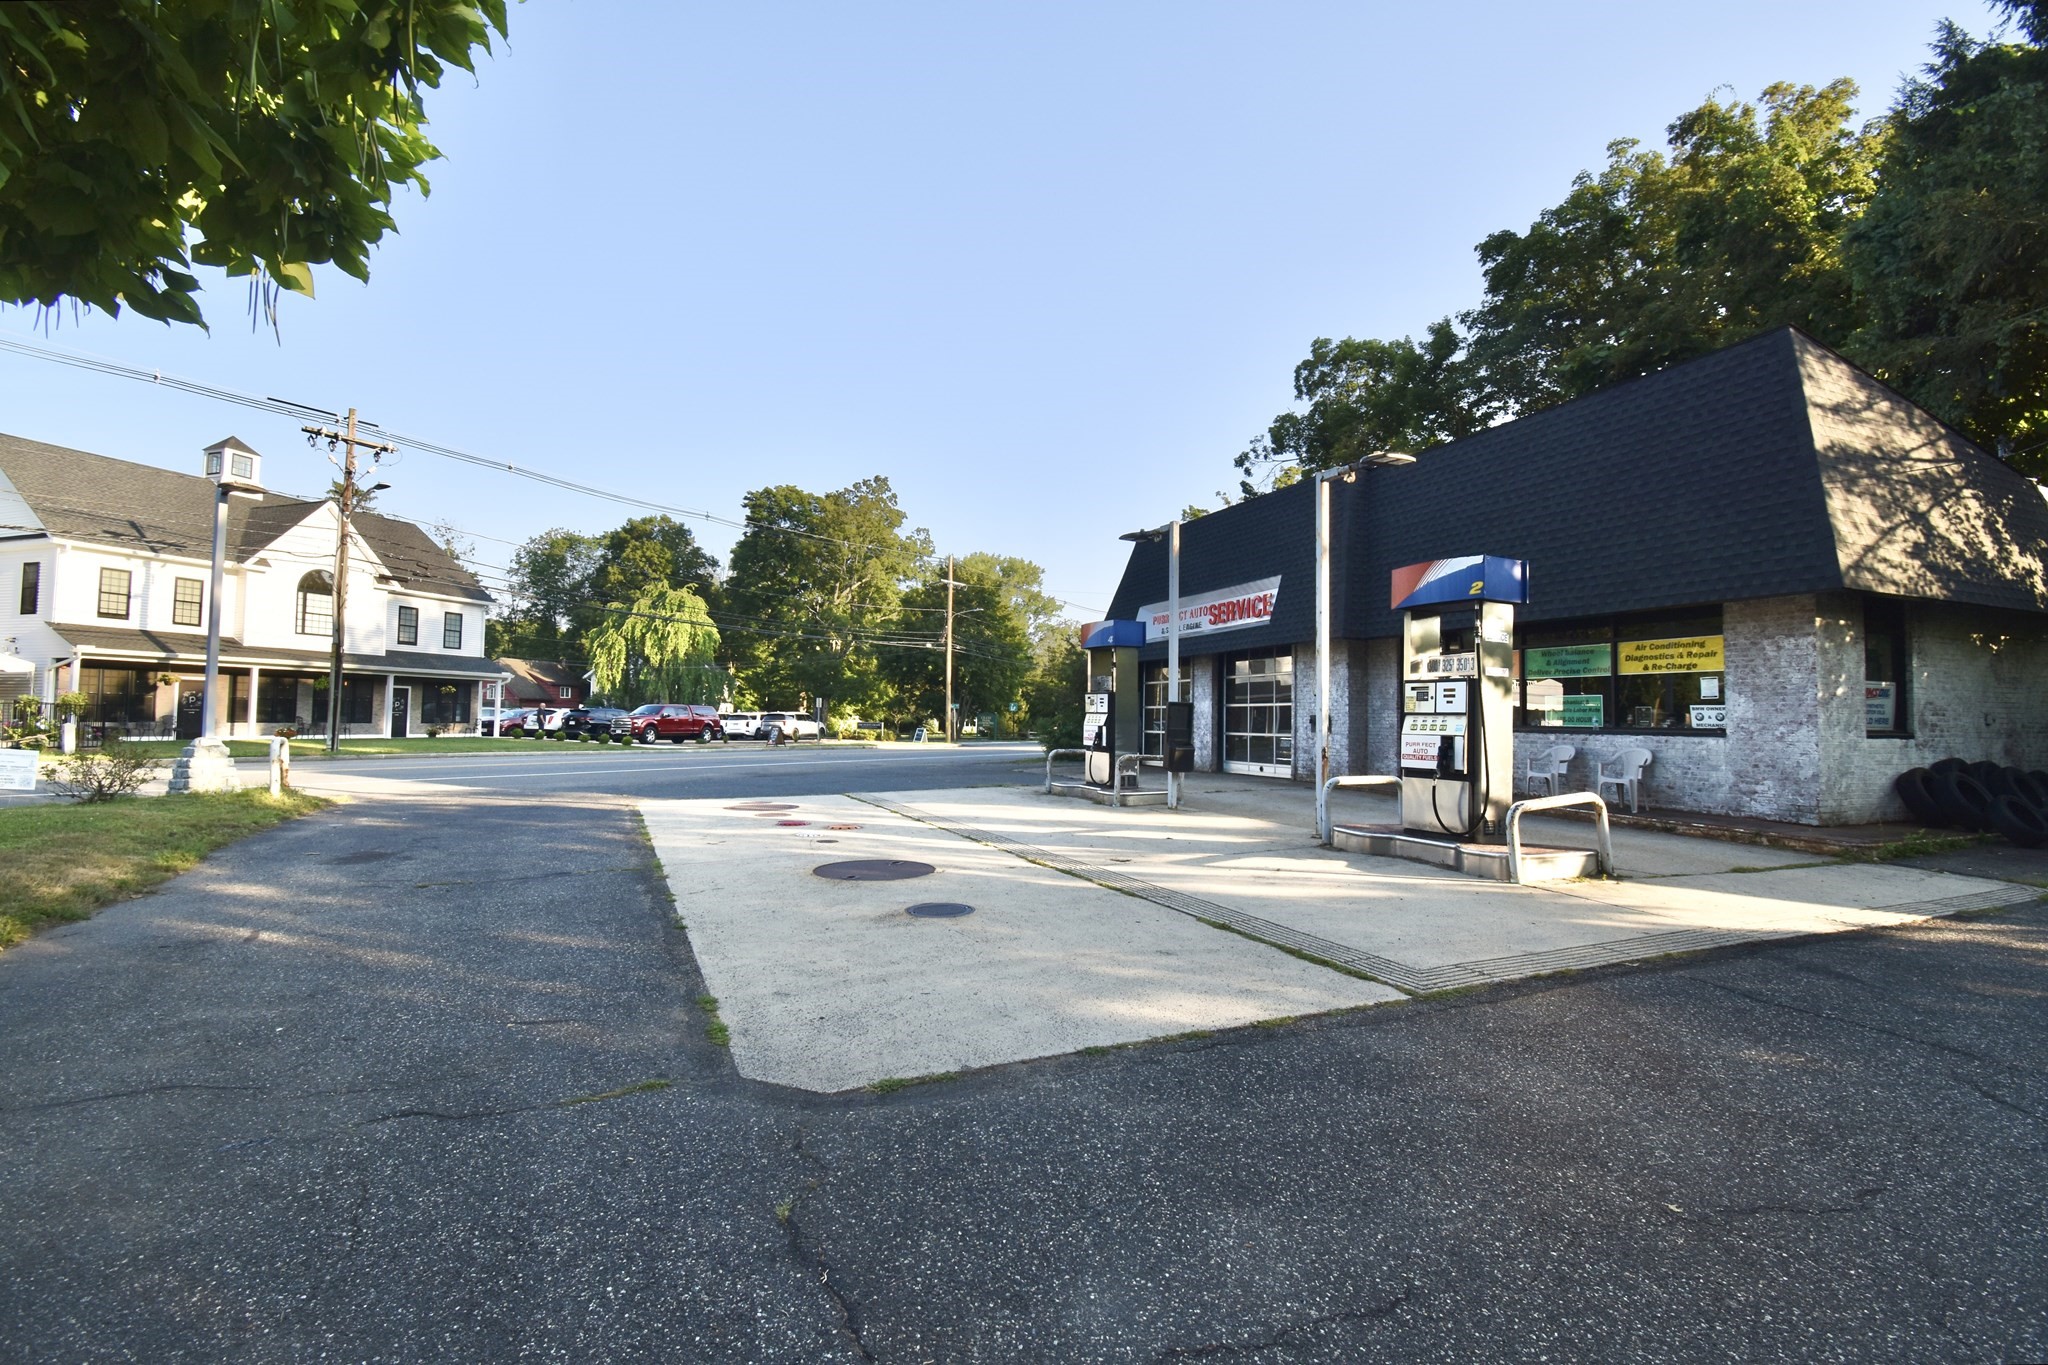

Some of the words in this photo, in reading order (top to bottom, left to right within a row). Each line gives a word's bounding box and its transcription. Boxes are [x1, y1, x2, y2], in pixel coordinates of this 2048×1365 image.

[1469, 581, 1484, 595] 2
[1152, 610, 1188, 625] PURRCT
[1189, 605, 1209, 619] AUTO
[1208, 592, 1273, 625] SERVICE
[1107, 635, 1114, 643] 4
[1648, 640, 1706, 651] Conditioning
[1625, 652, 1675, 662] Diagnostics
[1686, 650, 1718, 659] Repair
[1552, 658, 1590, 667] Alignment
[1651, 662, 1698, 670] Re-Charge
[1582, 666, 1611, 674] Control
